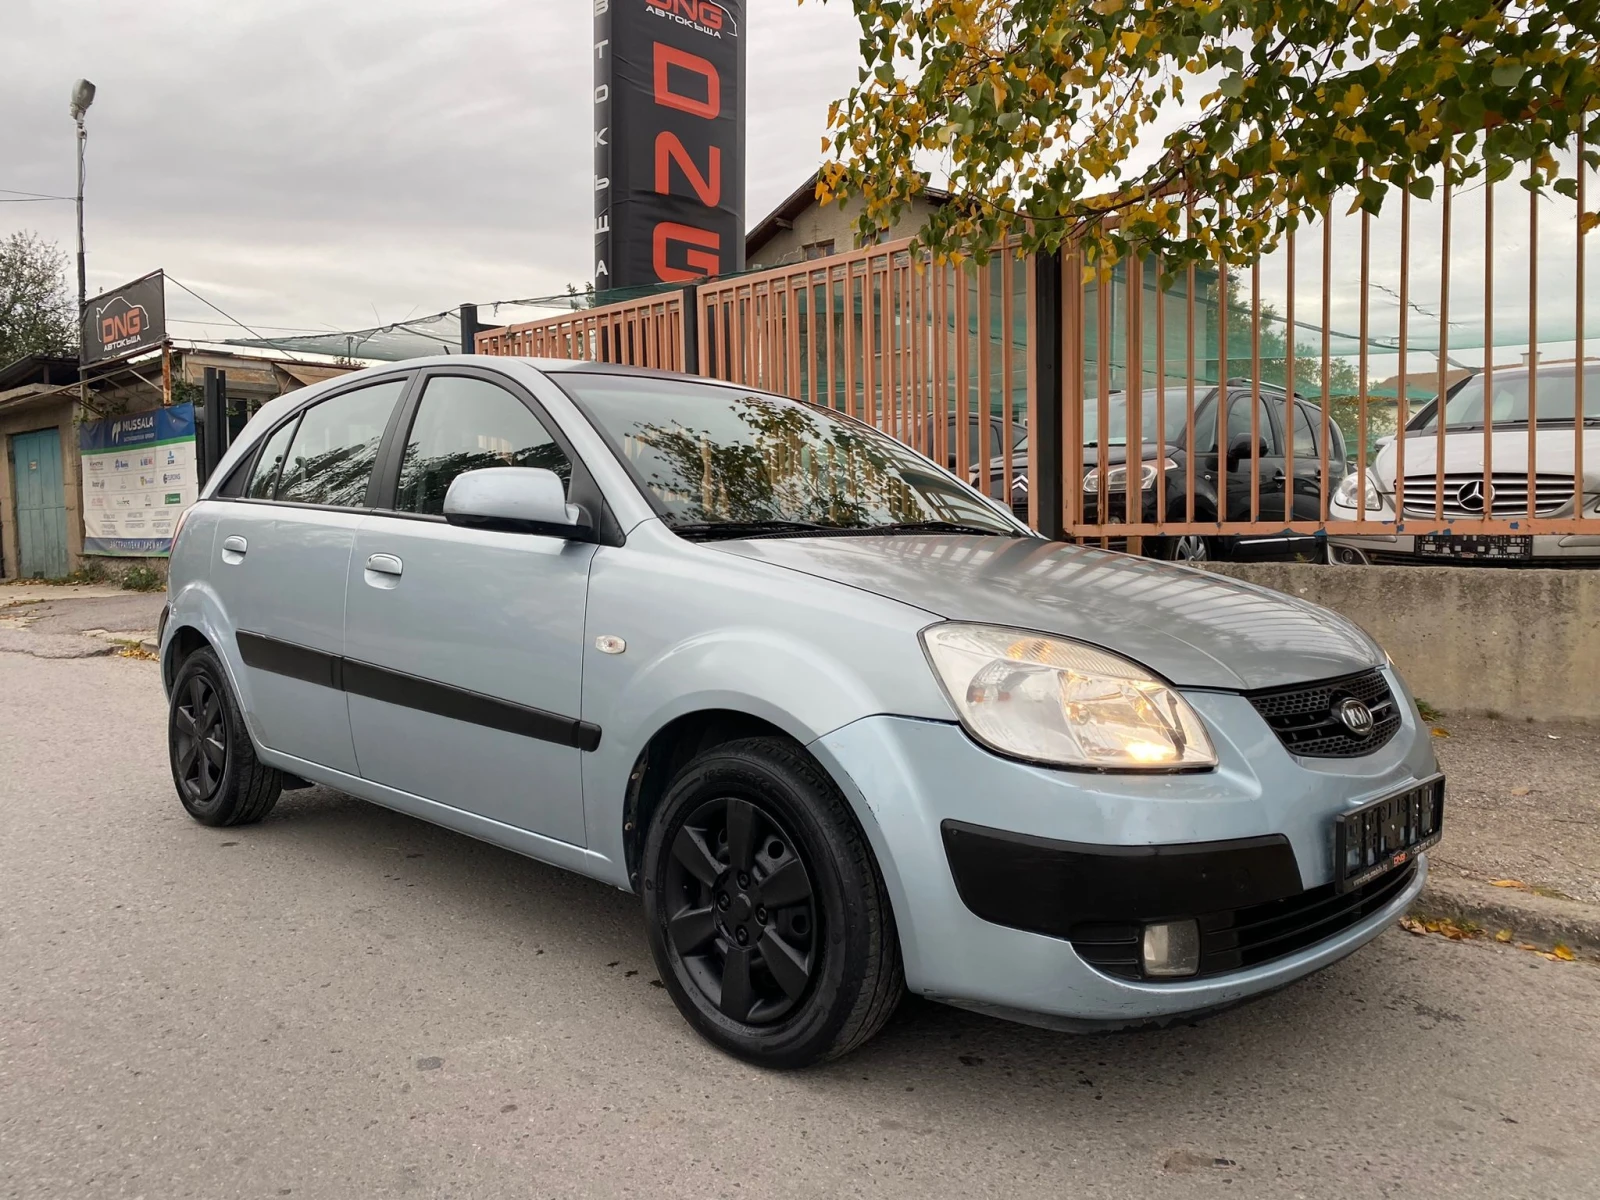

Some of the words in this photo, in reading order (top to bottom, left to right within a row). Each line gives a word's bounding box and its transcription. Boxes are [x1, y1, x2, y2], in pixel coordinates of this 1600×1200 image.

[102, 307, 141, 344] DNG
[122, 416, 154, 432] MUSSALA
[1346, 706, 1370, 727] KIA
